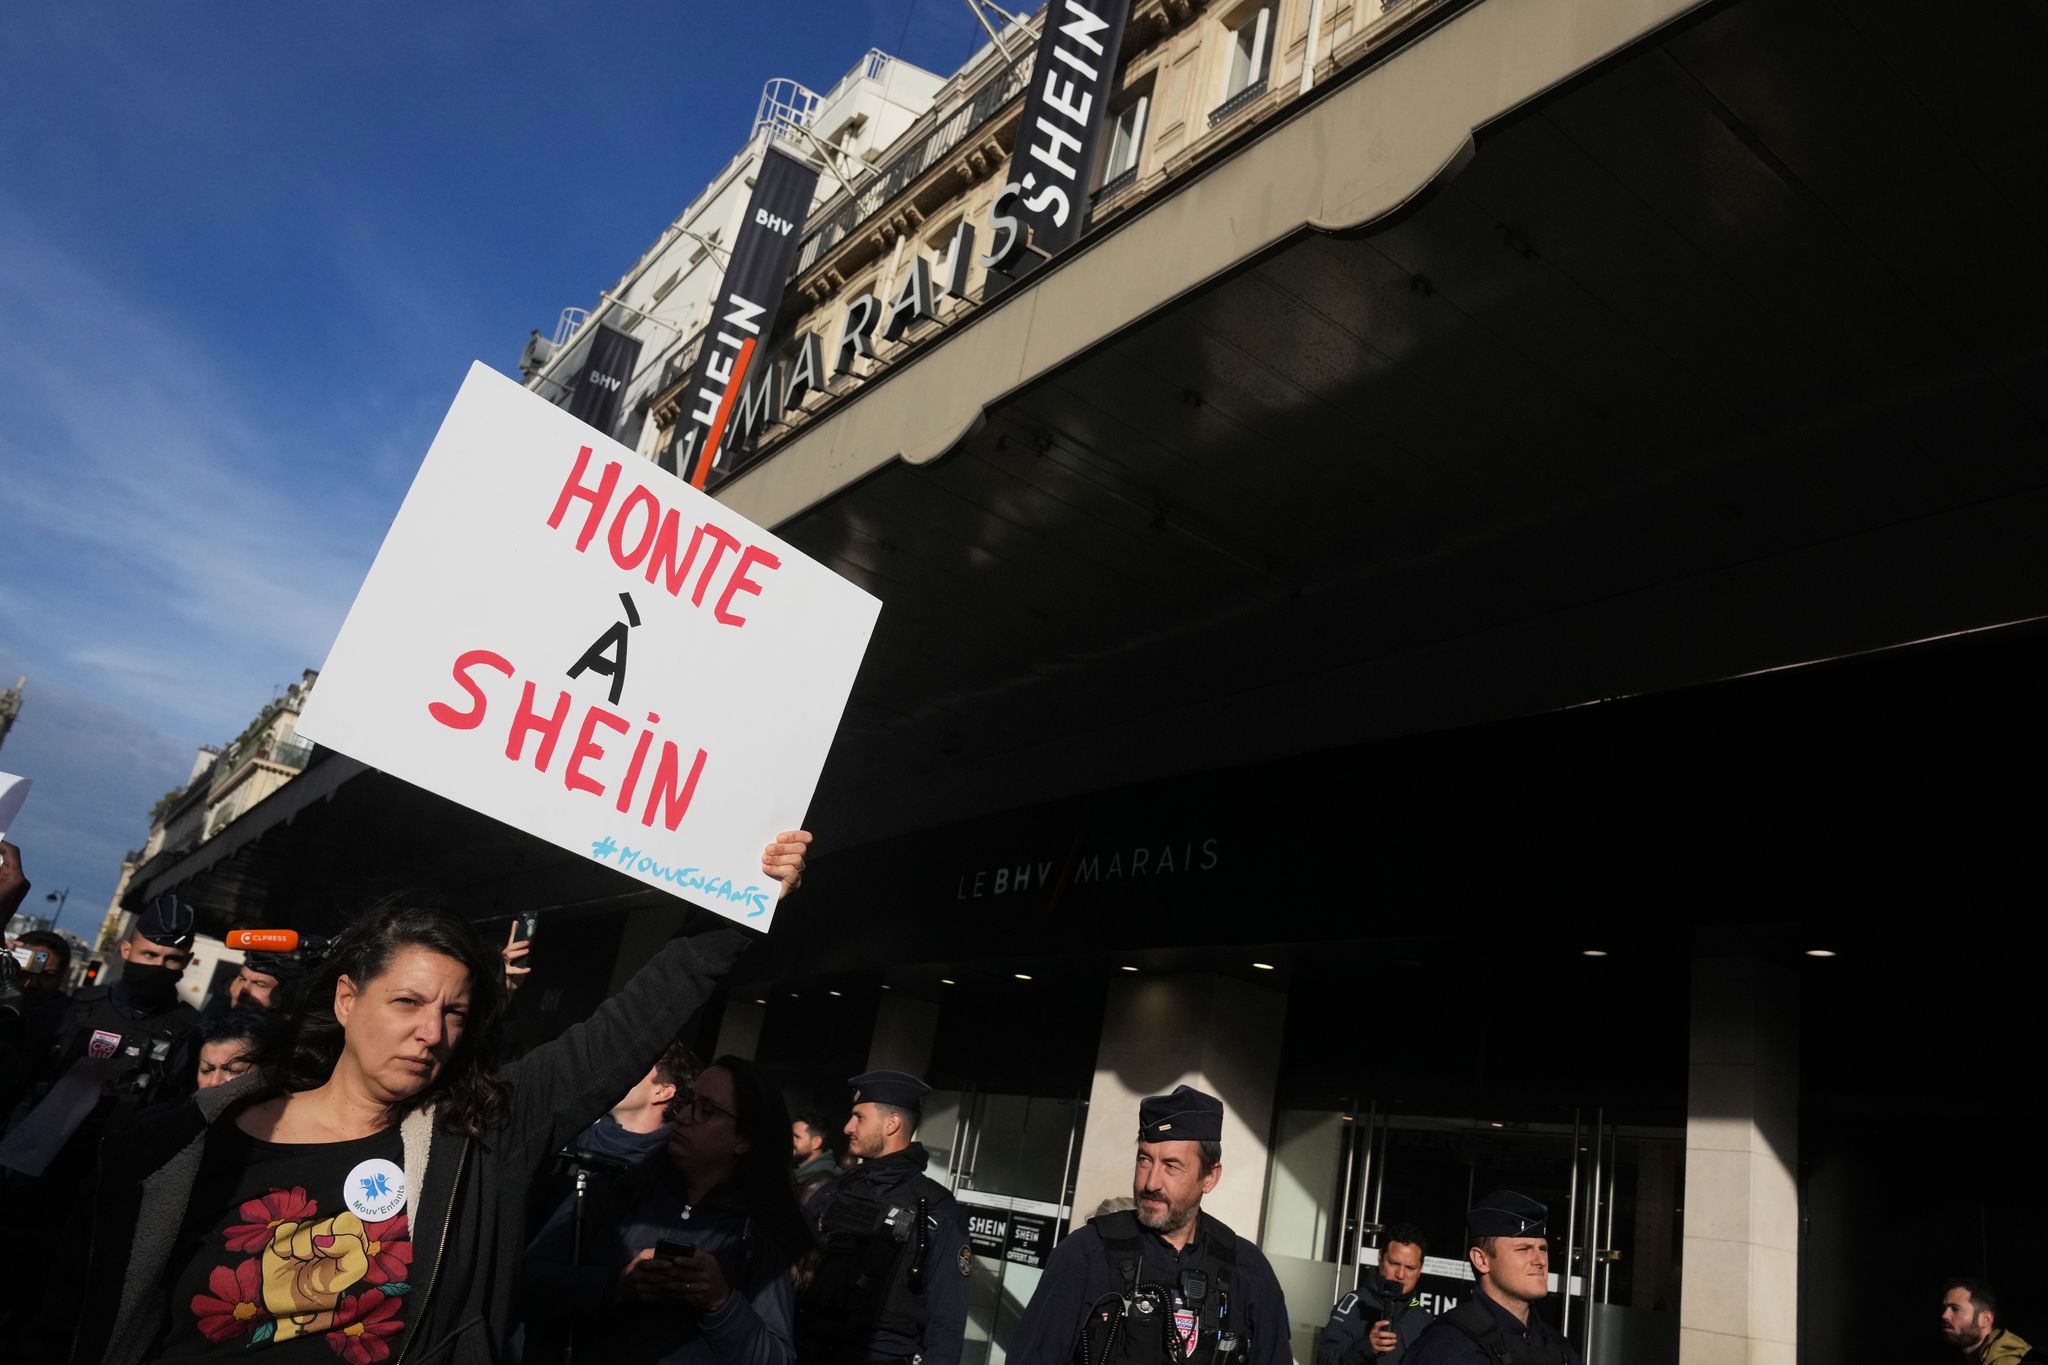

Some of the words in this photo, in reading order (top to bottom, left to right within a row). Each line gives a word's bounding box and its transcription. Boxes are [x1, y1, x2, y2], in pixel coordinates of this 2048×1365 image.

[1022, 0, 1110, 228] SHEIN
[755, 207, 793, 237] BHV
[727, 182, 1022, 450] MARAIS
[588, 369, 622, 393] BHV
[547, 445, 782, 628] HONTE
[566, 592, 642, 706] À
[957, 871, 987, 900] LE
[993, 860, 1053, 896] BHV
[1074, 837, 1219, 885] MARAIS
[92, 1042, 112, 1054] CRS
[353, 1185, 405, 1216] Mouv'Enfants
[968, 1216, 1007, 1237] SHEIN
[1014, 1228, 1040, 1243] SHEIN
